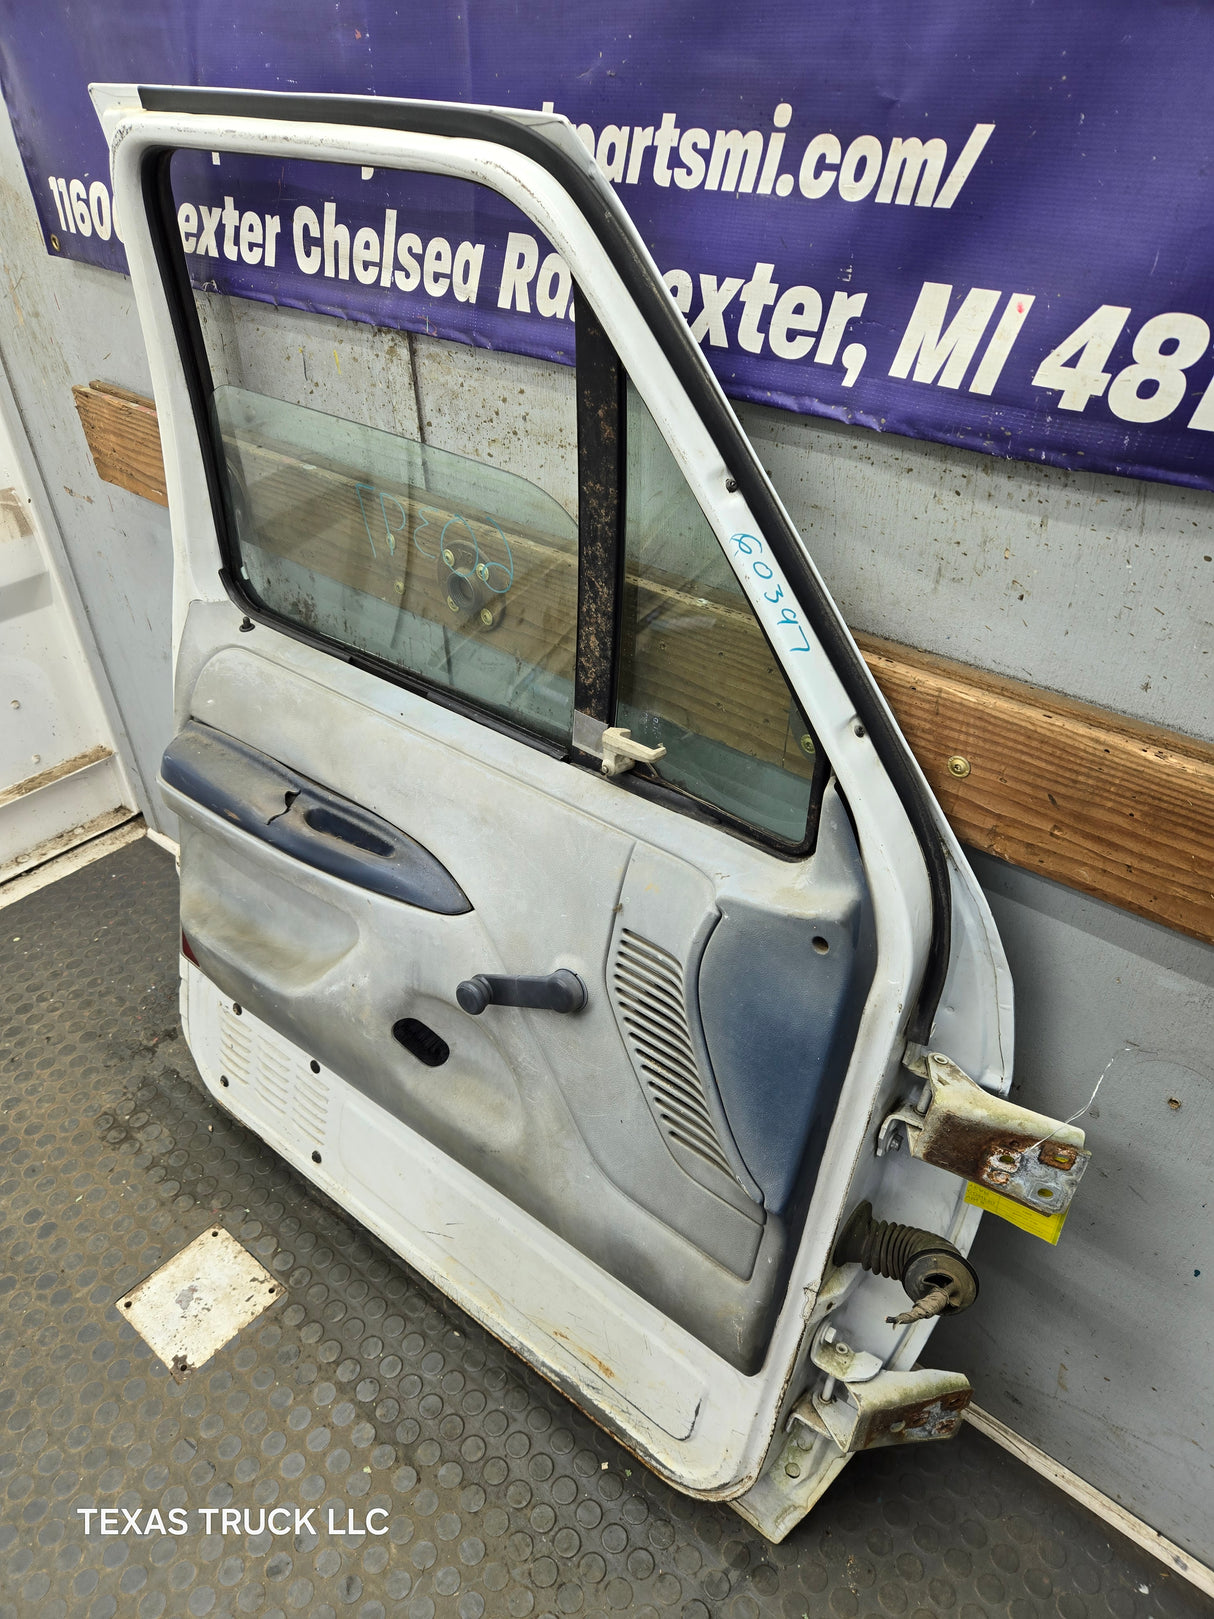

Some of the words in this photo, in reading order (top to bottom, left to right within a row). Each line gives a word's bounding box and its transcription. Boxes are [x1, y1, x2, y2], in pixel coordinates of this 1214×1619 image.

[48, 176, 125, 244] 1160
[177, 196, 281, 267] exter
[292, 202, 486, 304] Chelsea
[660, 262, 869, 388] exter,
[889, 282, 1036, 396] MI
[728, 533, 811, 652] 60397
